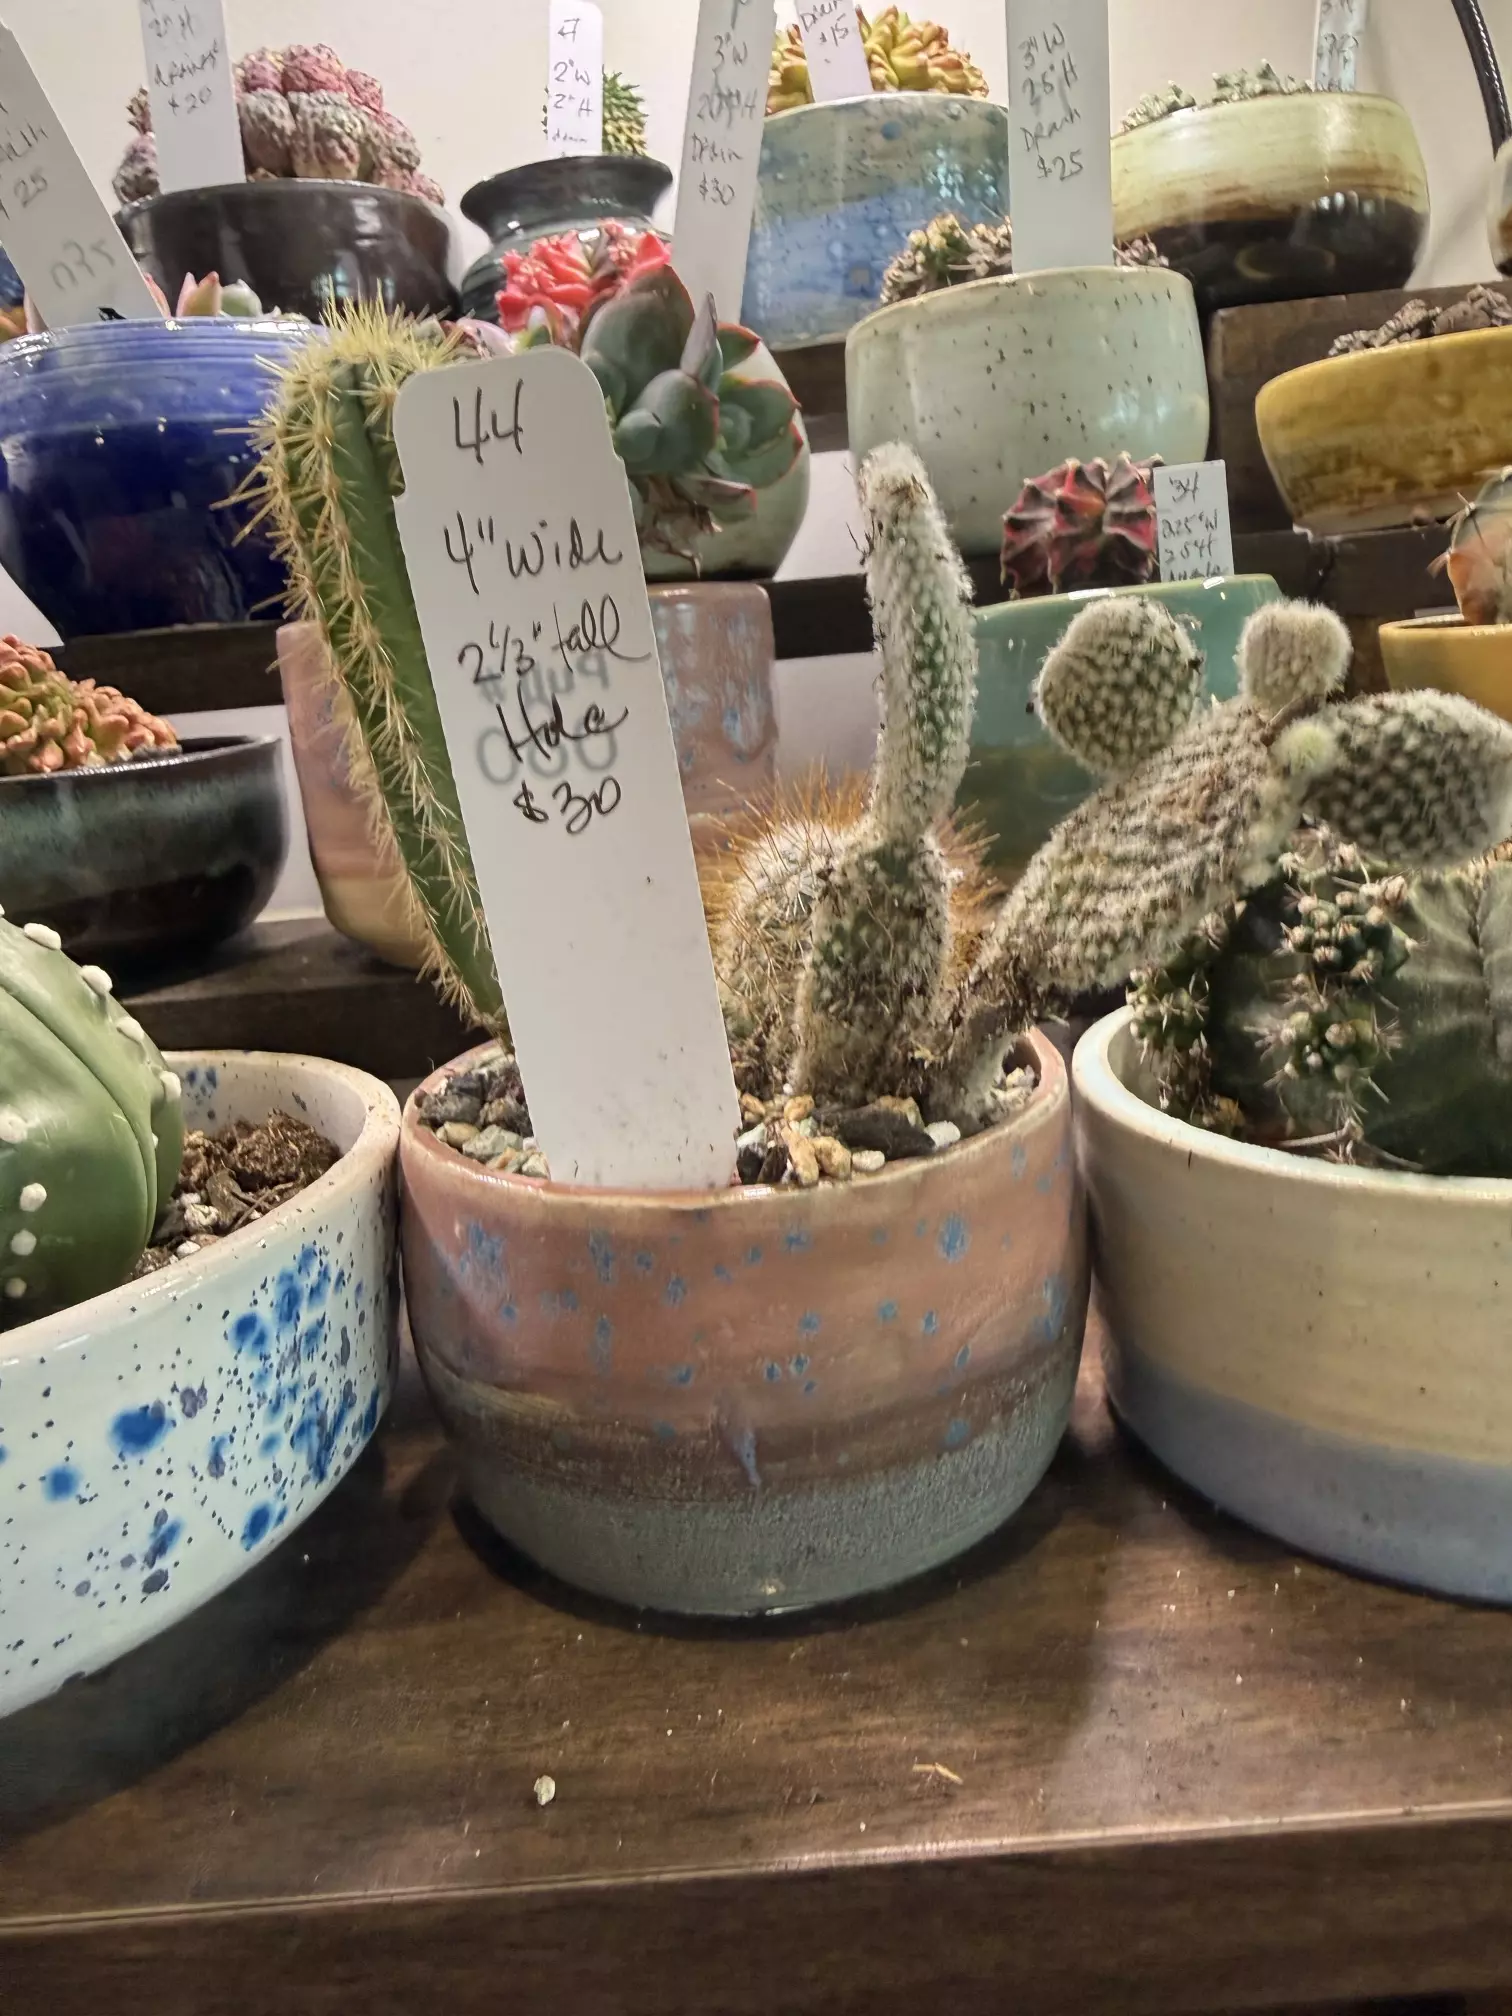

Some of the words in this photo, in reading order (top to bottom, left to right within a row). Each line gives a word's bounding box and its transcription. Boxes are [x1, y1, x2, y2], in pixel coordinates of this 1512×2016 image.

[1036, 149, 1084, 182] $25
[452, 378, 524, 466] 44
[550, 593, 652, 674] tall
[512, 775, 623, 836] $30
